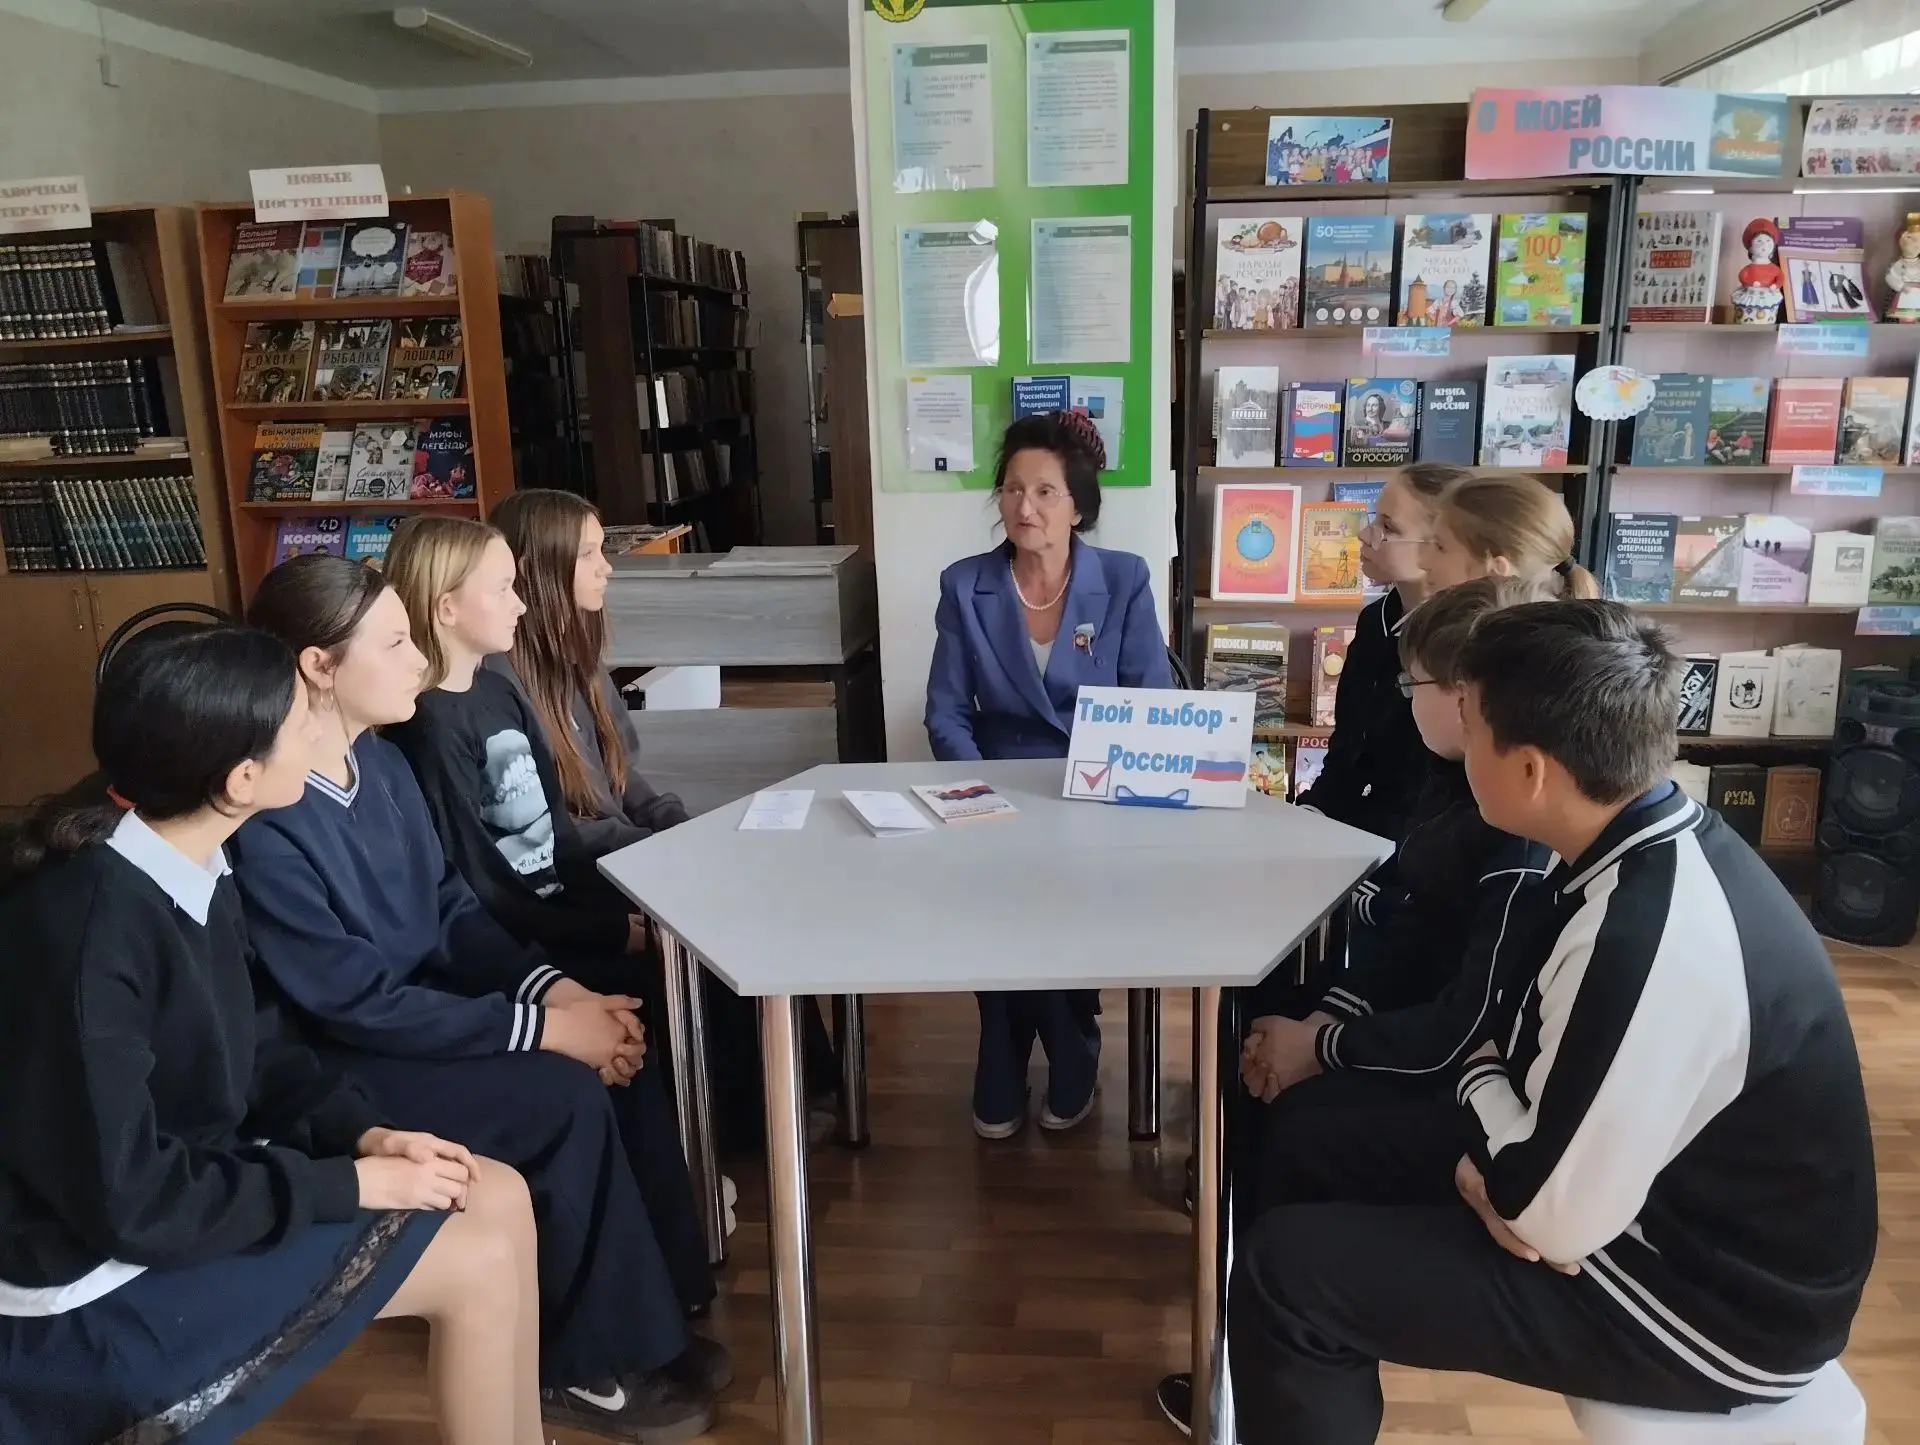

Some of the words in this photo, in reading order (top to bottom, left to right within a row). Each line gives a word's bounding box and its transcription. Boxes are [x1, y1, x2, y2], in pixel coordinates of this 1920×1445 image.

[1477, 100, 1496, 132] О
[1515, 93, 1603, 132] МОЕЙ
[1569, 135, 1695, 172] РОССИИ
[287, 171, 352, 186] НОВЫЕ
[0, 183, 78, 199] АВОЧНАЯ
[258, 194, 383, 210] ПОСТУПЛЕНИЯ
[0, 202, 81, 218] ТЕРАТУРА
[1315, 225, 1334, 239] 50
[1524, 234, 1563, 256] 100
[1238, 259, 1283, 269] НАРОДЫ
[1236, 269, 1282, 279] РОССИИ
[256, 353, 296, 366] ОХОТА
[323, 351, 381, 365] РЫБАЛКА
[402, 350, 454, 361] ЛОШАДИ
[1016, 384, 1063, 393] Конституция
[1434, 387, 1466, 396] КНИГА
[1020, 392, 1060, 400] Российской
[1021, 401, 1060, 409] Федерации
[1296, 402, 1328, 411] ИСТОРИЯ
[1430, 401, 1470, 411] РОССИИ
[429, 430, 462, 439] МИФЫ
[421, 441, 468, 450] ЛЕГЕНДЫ
[1352, 454, 1361, 462] О
[1362, 453, 1404, 463] РОССИИ
[319, 519, 340, 531] 4D
[283, 533, 341, 545] КОСМОС
[1616, 529, 1670, 538] СВЯЩЕННАЯ
[1622, 537, 1663, 545] ВОЕННАЯ
[1617, 544, 1665, 553] ОПЕРАЦИЯ:
[1213, 637, 1249, 650] НОЖИ
[1251, 638, 1285, 652] МИРА
[1078, 697, 1134, 724] Твой
[1146, 702, 1223, 735] выбор
[1301, 737, 1329, 748] РОС
[1107, 744, 1194, 775] Россия
